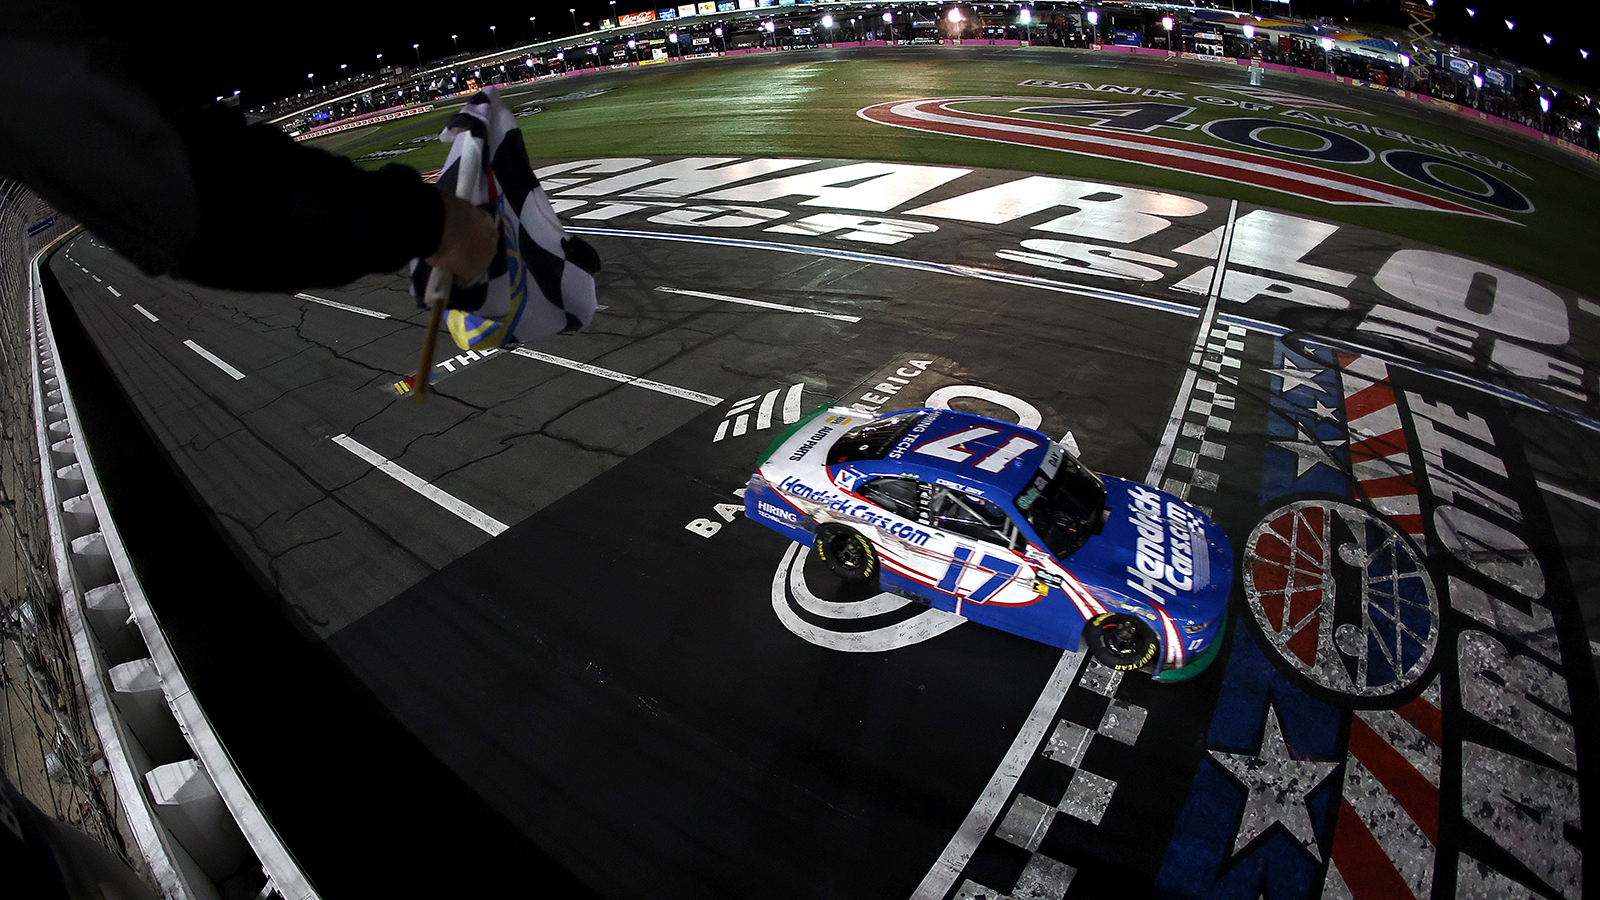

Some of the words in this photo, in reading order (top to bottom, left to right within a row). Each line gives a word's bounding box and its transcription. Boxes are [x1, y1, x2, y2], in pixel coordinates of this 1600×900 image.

[1016, 79, 1188, 100] BANK
[1193, 95, 1274, 111] OF
[1279, 109, 1535, 181] AMERICA
[1008, 101, 1537, 214] 400
[553, 198, 940, 246] TOR
[532, 156, 1600, 346] CHARLO
[436, 347, 499, 374] THE
[789, 440, 816, 462] PARTS
[811, 425, 834, 442] AUTO
[888, 431, 921, 460] TECHS
[912, 426, 1040, 473] 17
[757, 500, 798, 523] HIRING
[1126, 485, 1177, 605] Hendrick
[1164, 501, 1194, 591] Cars.com
[936, 545, 1021, 604] 17
